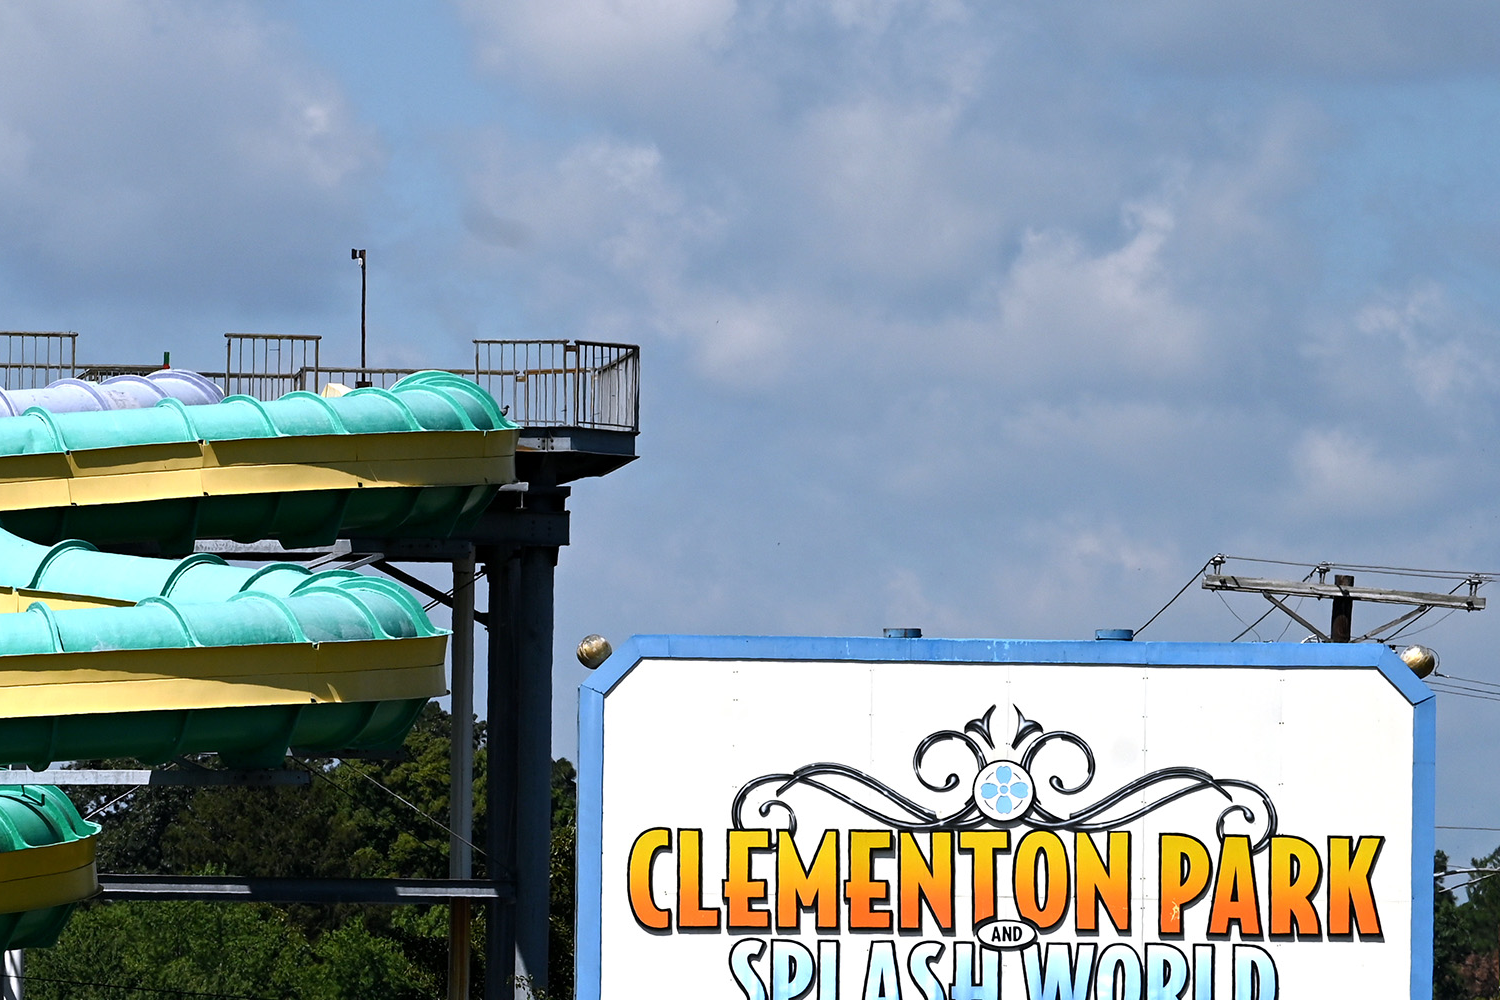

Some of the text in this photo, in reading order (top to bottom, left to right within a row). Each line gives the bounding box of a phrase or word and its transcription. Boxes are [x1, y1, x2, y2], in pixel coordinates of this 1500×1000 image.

[626, 827, 1386, 943] CLEMENTON PARK
[991, 926, 1022, 942] AND
